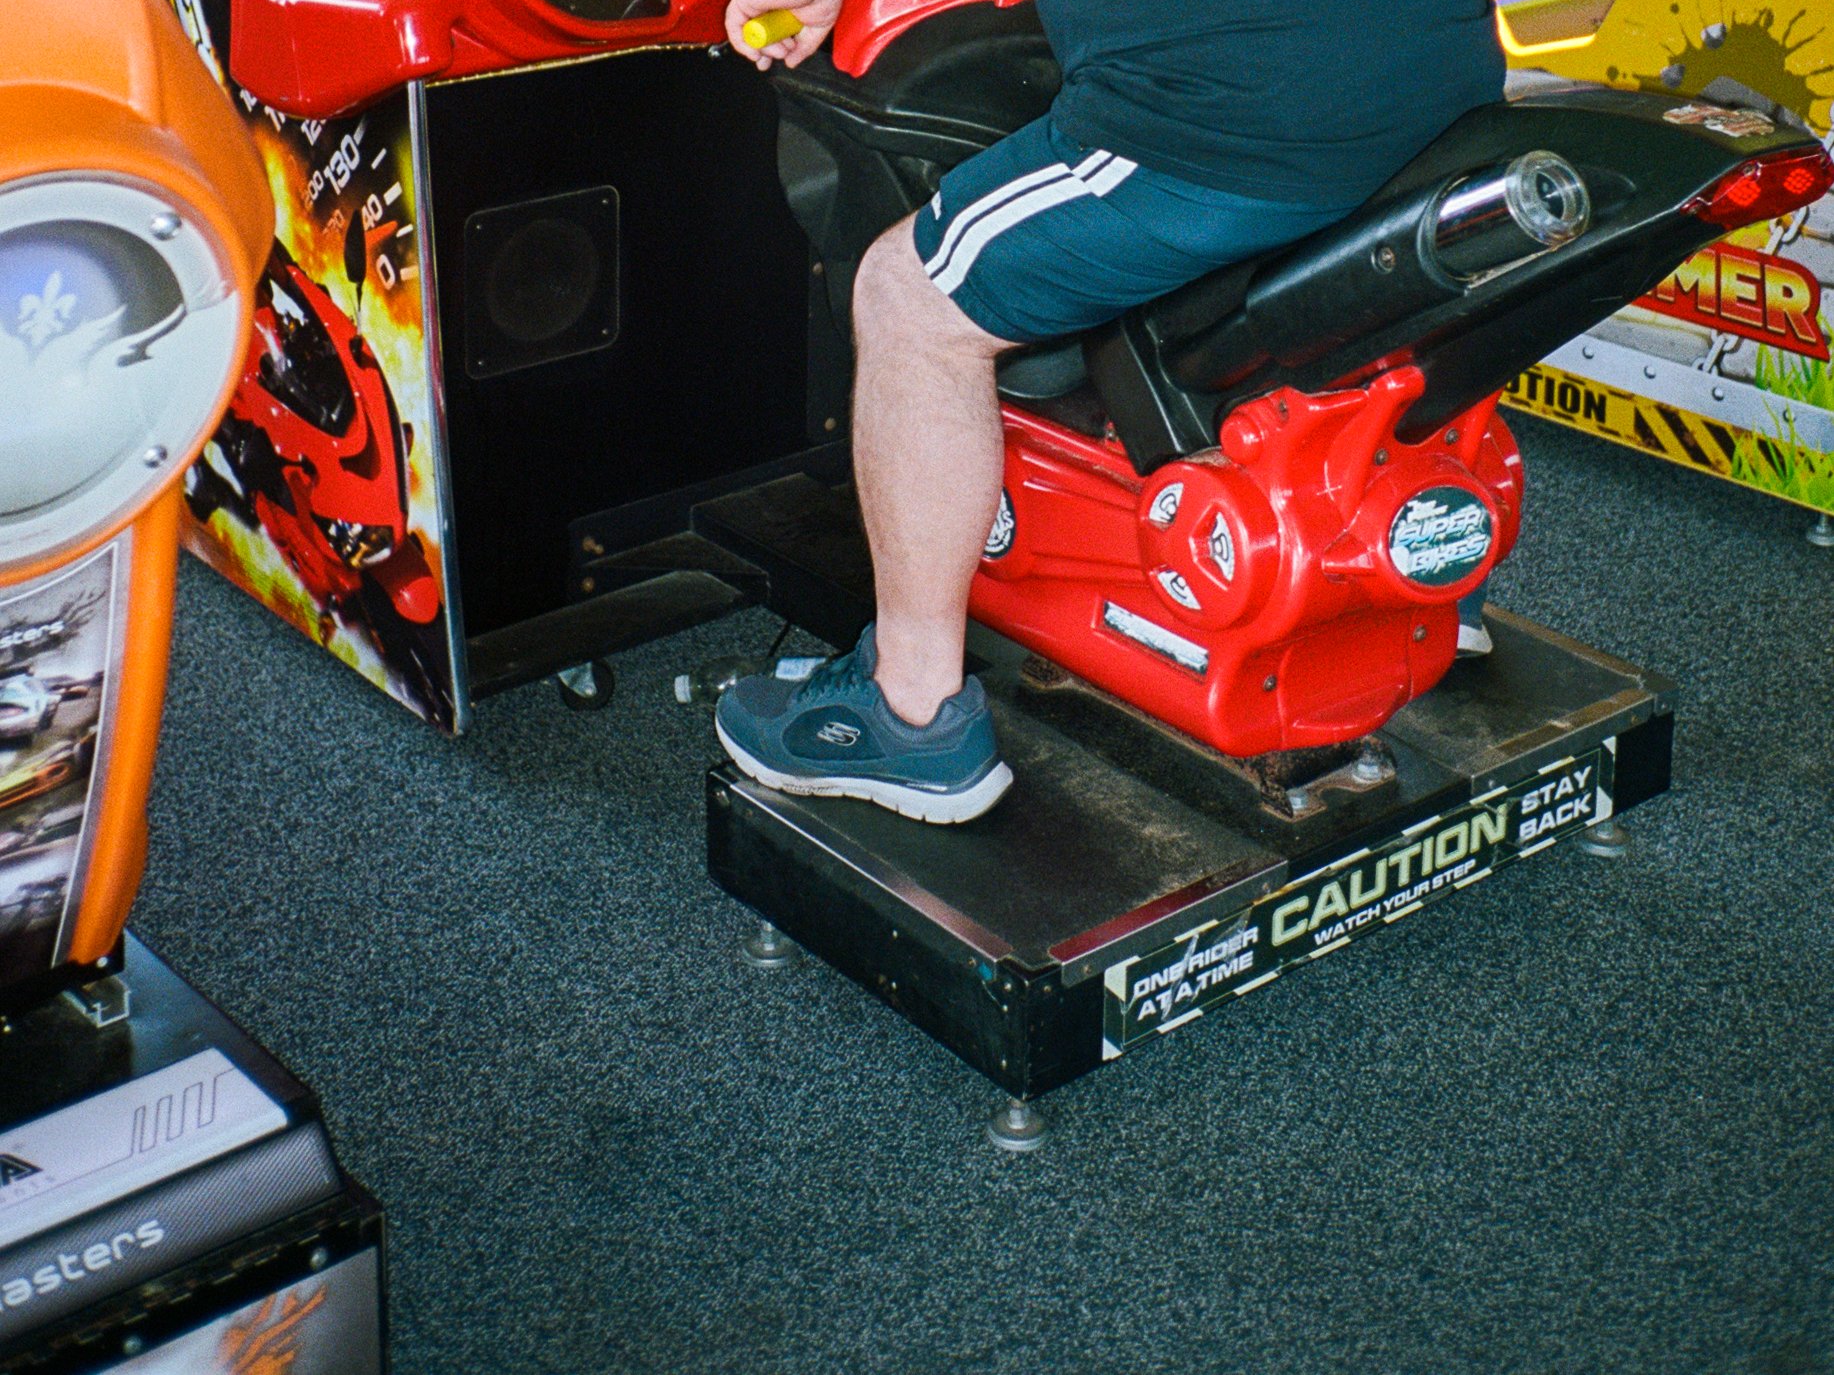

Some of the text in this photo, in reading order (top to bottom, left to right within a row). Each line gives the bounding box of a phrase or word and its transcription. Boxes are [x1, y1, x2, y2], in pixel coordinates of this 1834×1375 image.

[300, 120, 327, 146] 12
[324, 134, 360, 195] 130
[1656, 248, 1817, 343] MER
[1396, 505, 1483, 547] SUPER
[1519, 792, 1592, 841] BACK
[1521, 766, 1592, 815] STAY
[1272, 803, 1508, 947] CAUTION
[1314, 858, 1476, 946] WATCH YOUR STEP
[1134, 926, 1259, 999] ONE RIDER
[1137, 950, 1253, 1021] AT A TIME
[0, 1220, 165, 1309] asters
